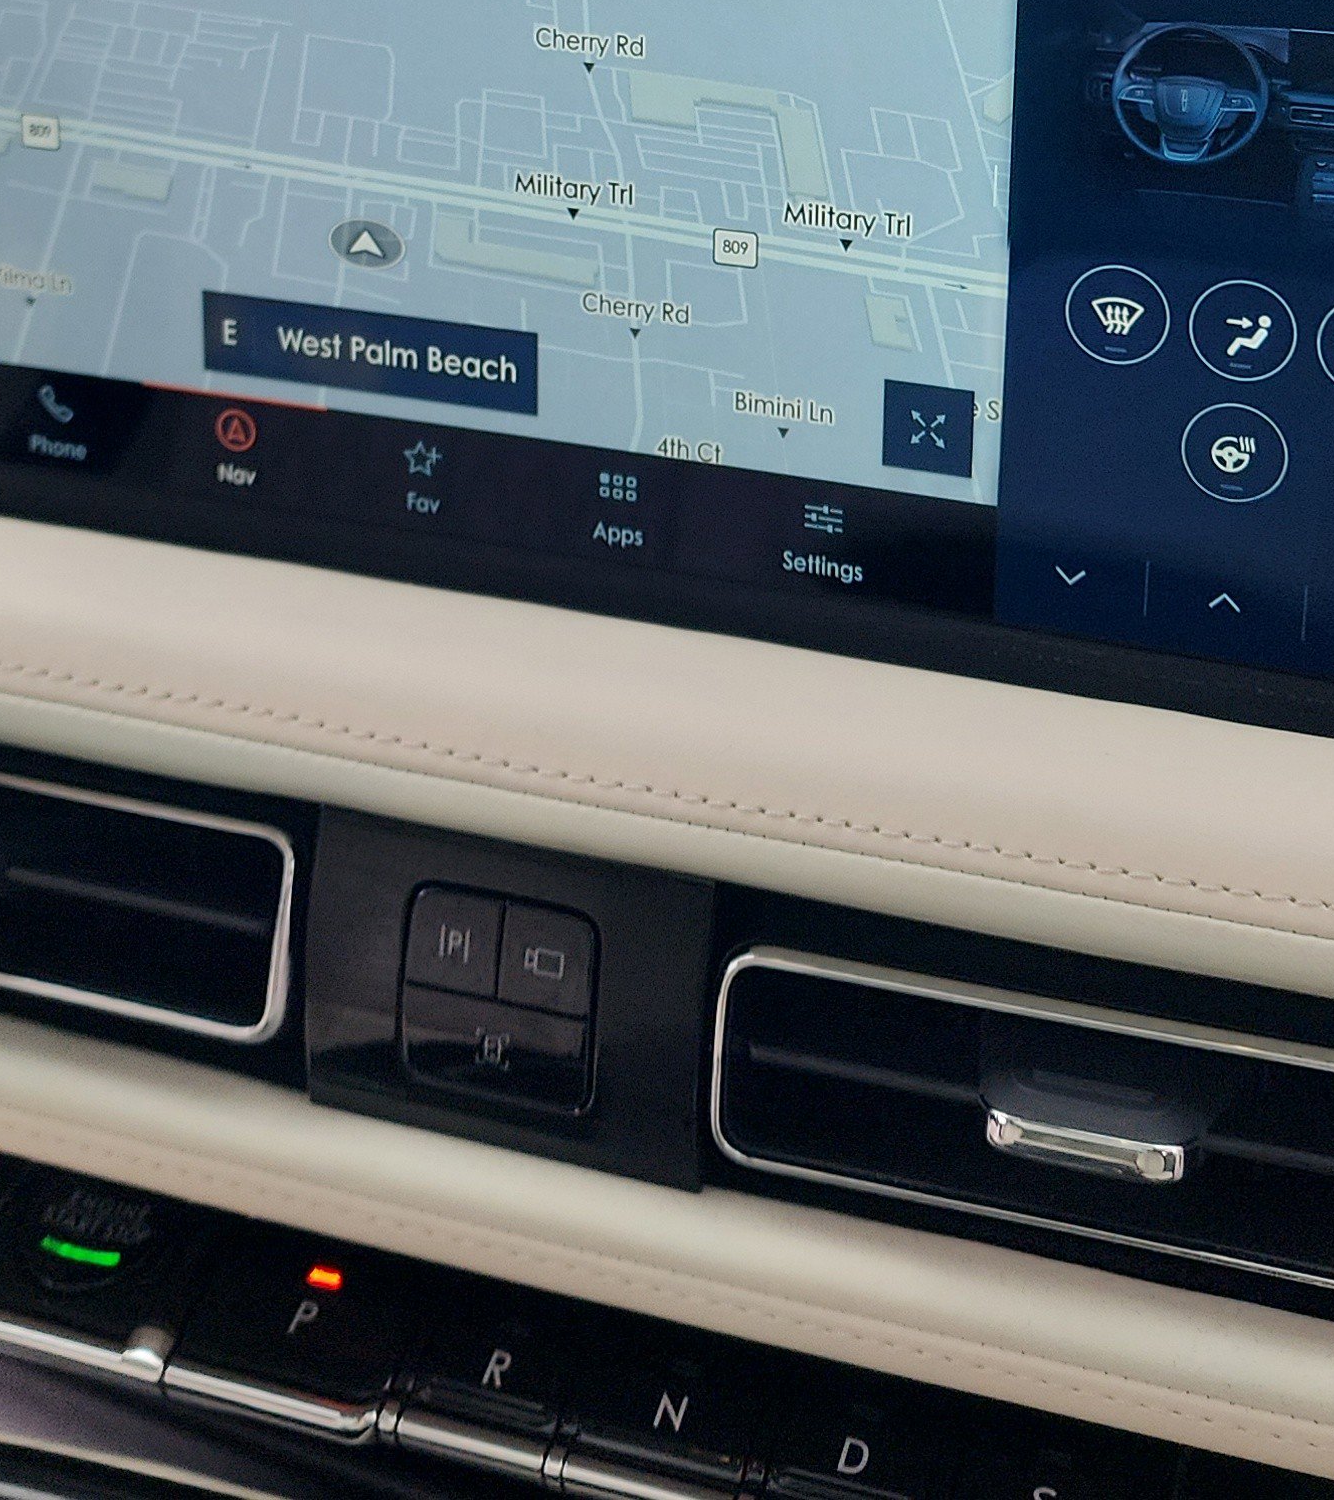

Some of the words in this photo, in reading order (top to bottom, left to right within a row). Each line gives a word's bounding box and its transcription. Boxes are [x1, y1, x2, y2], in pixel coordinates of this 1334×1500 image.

[535, 27, 609, 58] Cherry
[616, 35, 645, 57] Rd
[515, 175, 601, 205] Military
[607, 182, 634, 206] Trl
[783, 202, 876, 238] Military
[884, 213, 912, 237] Trl
[722, 239, 749, 257] 809
[582, 293, 654, 323] Cherry
[662, 303, 690, 325] Rd
[222, 320, 238, 346] E
[277, 327, 342, 360] West
[350, 337, 418, 370] Palm
[427, 346, 517, 383] Beach
[734, 392, 803, 420] Bimini
[809, 403, 834, 425] Ln
[28, 434, 87, 462] Phone
[657, 439, 690, 459] 4th
[697, 443, 721, 463] Ct
[217, 462, 256, 487] Nav
[406, 492, 441, 515] Fav
[593, 521, 644, 548] Apps
[782, 550, 863, 582] Settings
[288, 1300, 319, 1334] P
[482, 1349, 512, 1387] R
[653, 1392, 689, 1432] N
[837, 1437, 869, 1474] D
